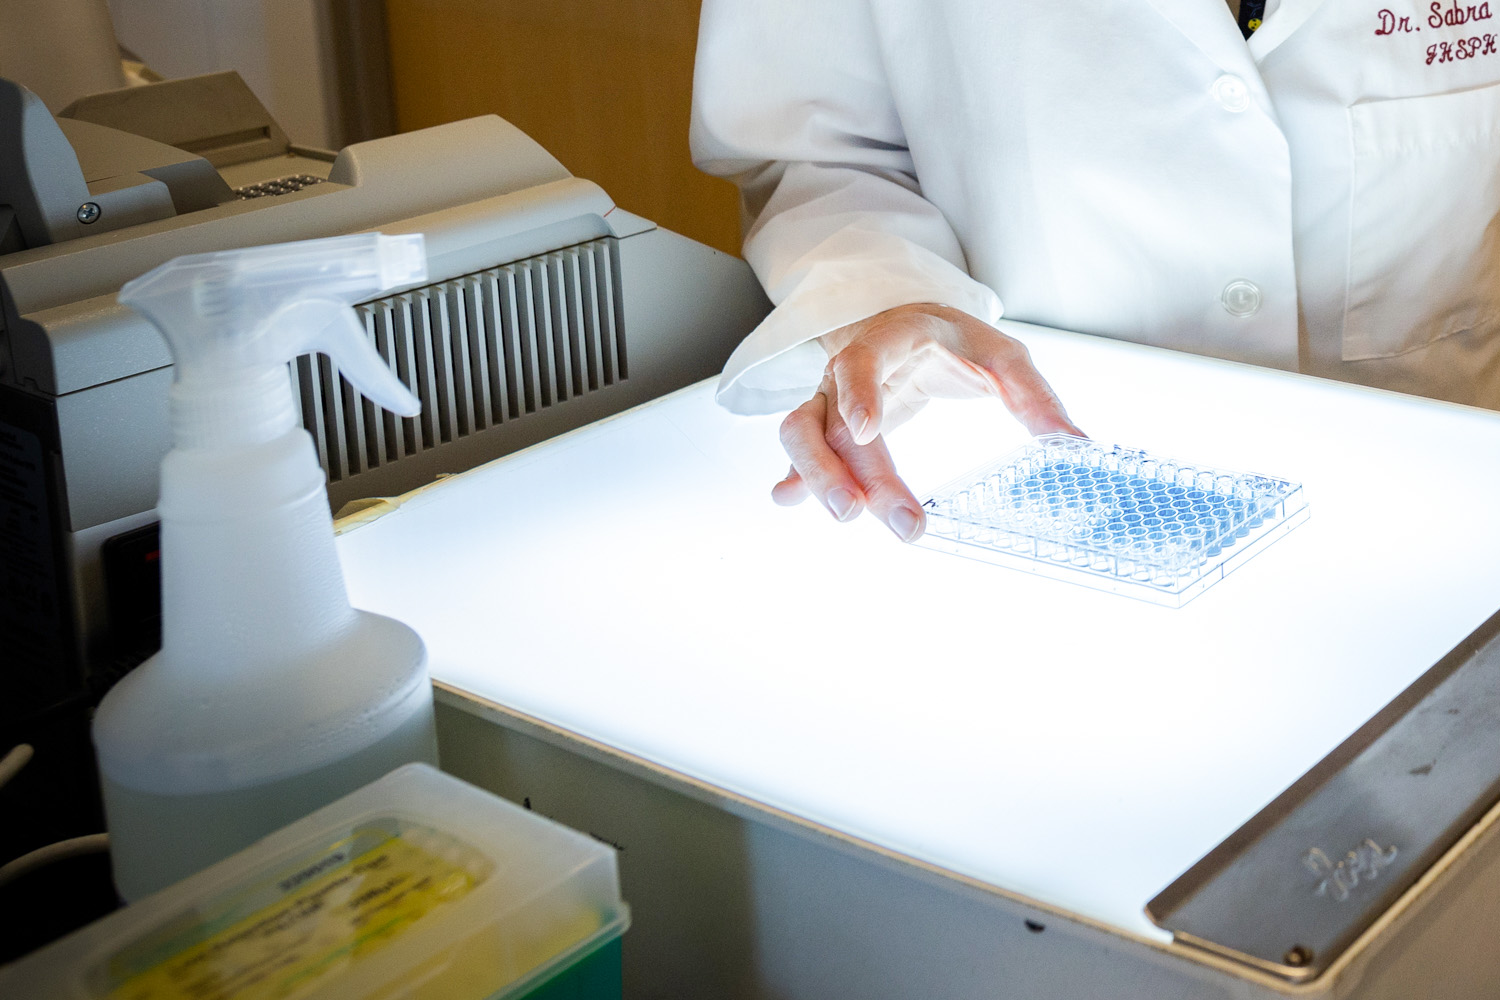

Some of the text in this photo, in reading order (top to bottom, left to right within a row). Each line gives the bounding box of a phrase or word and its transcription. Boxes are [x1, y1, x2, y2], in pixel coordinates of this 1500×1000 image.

[1375, 8, 1420, 36] Dr.
[1428, 0, 1493, 28] Sabra
[1425, 33, 1498, 65] JHSPH
